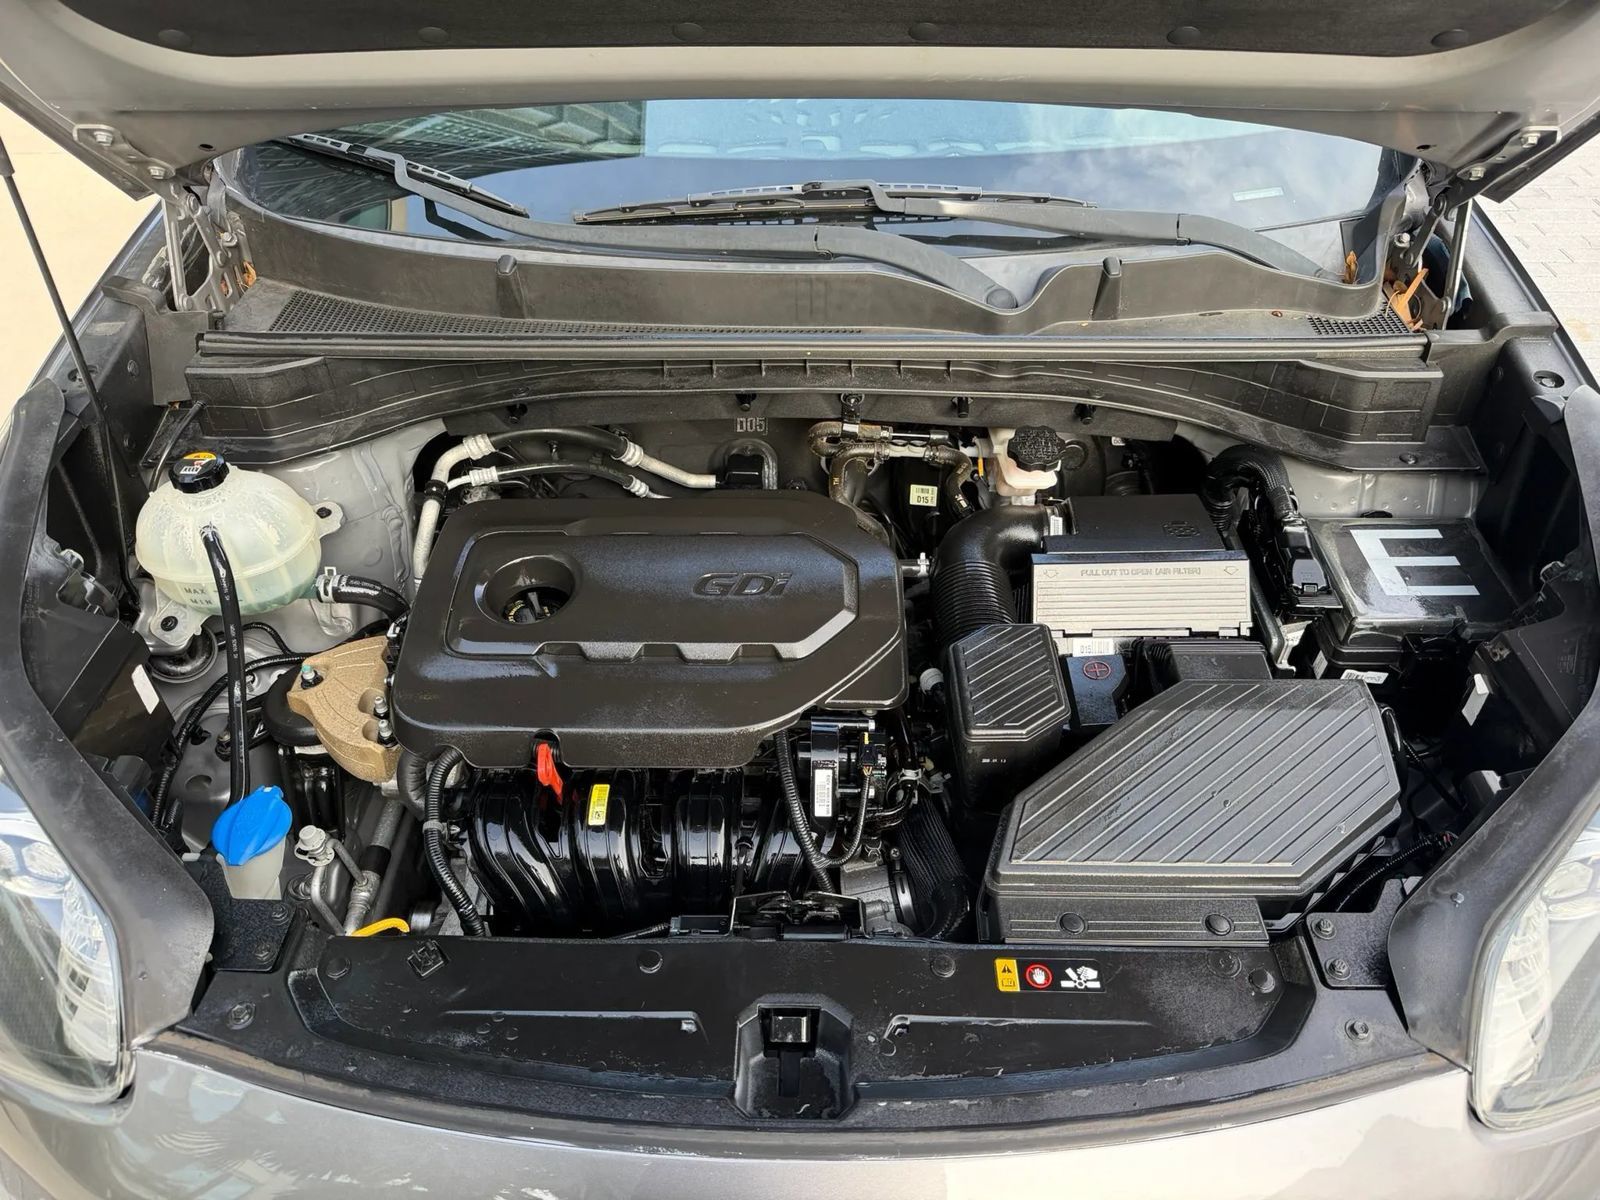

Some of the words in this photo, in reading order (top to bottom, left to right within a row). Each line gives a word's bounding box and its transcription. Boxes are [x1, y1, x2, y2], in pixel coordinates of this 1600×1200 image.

[1349, 528, 1480, 596] E
[1080, 569, 1101, 577] PULL
[1101, 568, 1117, 576] OUT
[1119, 568, 1130, 576] TO
[1131, 567, 1152, 576] OPEN
[184, 587, 206, 595] MAX
[692, 572, 793, 597] GDi
